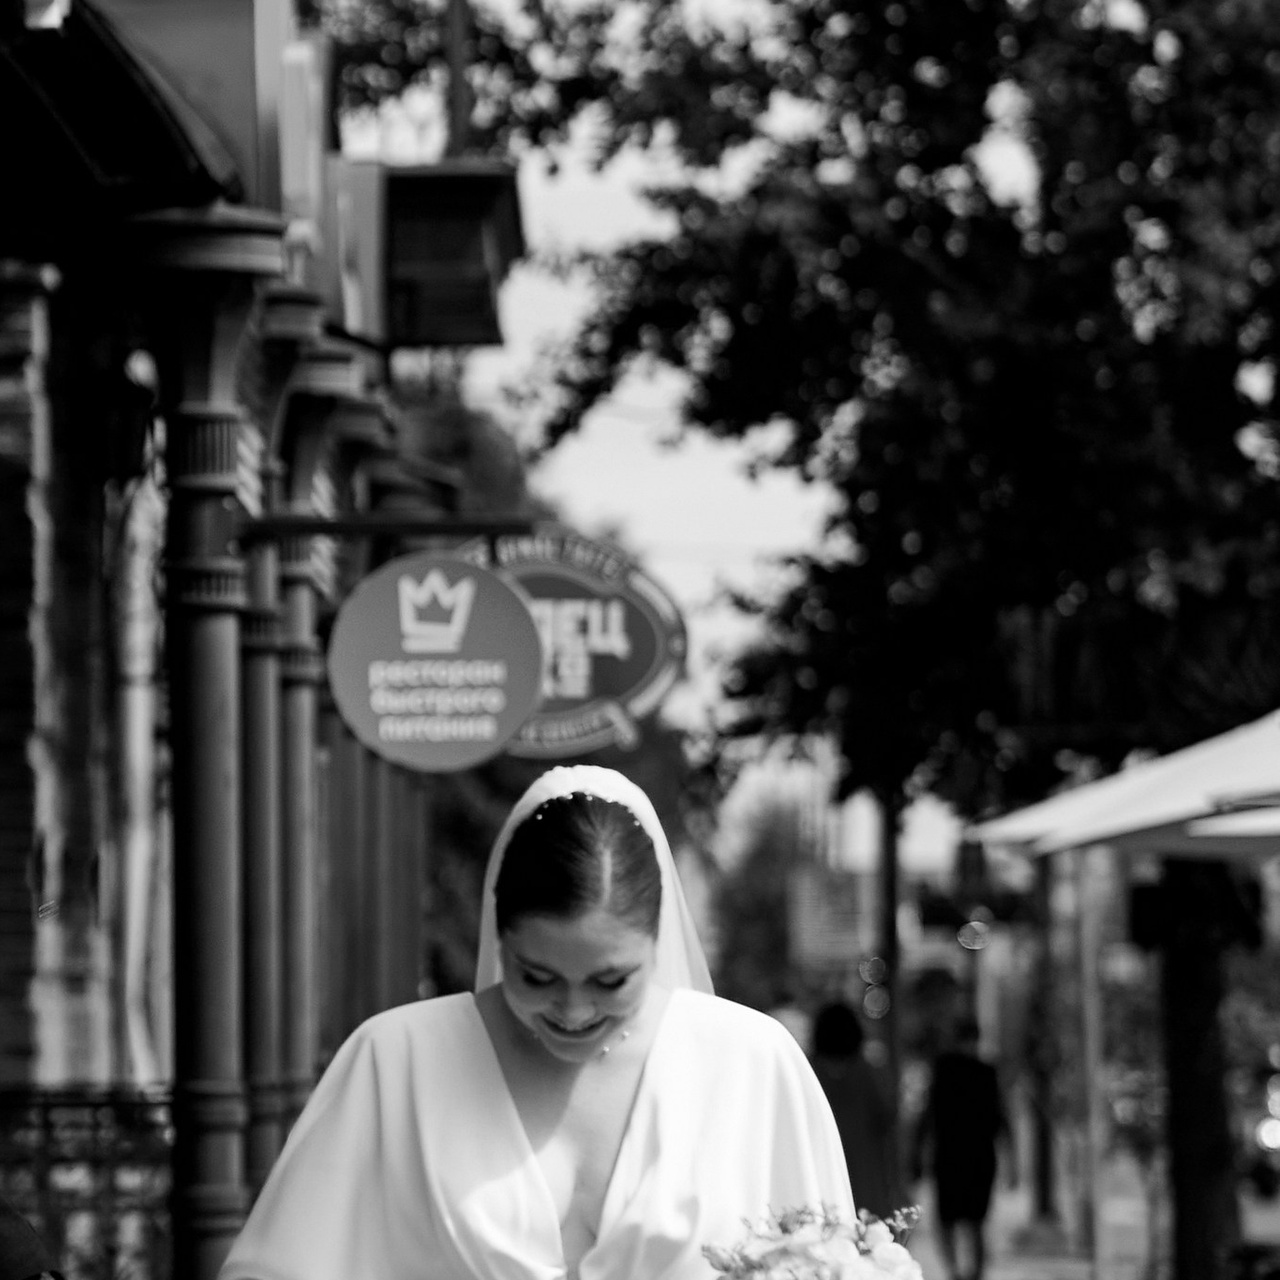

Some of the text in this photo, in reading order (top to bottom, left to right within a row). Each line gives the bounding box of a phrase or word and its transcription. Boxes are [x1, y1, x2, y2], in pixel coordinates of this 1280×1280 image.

[368, 660, 506, 688] ресторан
[370, 686, 506, 716] быстрого
[379, 716, 497, 741] питания
